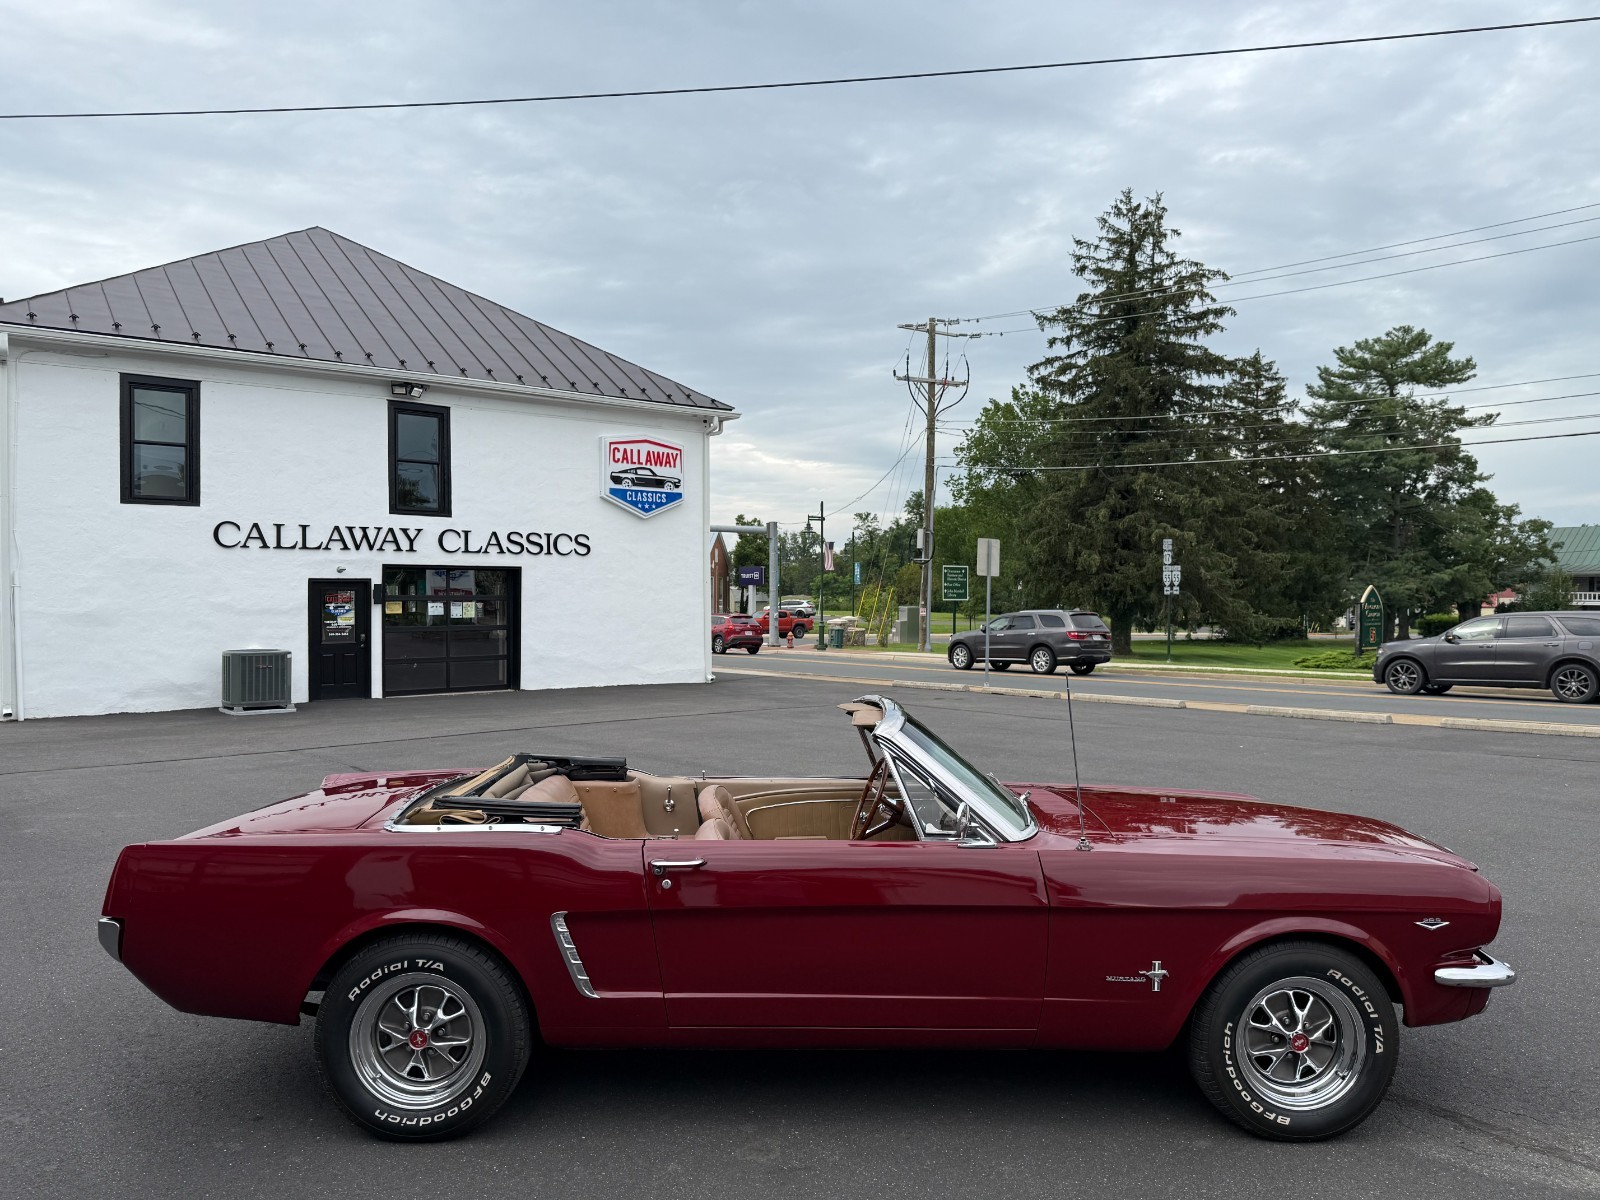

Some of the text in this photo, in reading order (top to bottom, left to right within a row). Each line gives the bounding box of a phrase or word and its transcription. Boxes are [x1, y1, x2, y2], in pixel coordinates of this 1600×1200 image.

[612, 446, 678, 468] CALLAWAY
[626, 491, 666, 502] CLASSICS
[212, 520, 591, 556] CALLAWAY CLASSICS
[348, 959, 445, 1001] Radial T/A
[1326, 968, 1384, 1054] Radial T/A
[1222, 1022, 1291, 1126] BFGoodrich
[374, 1071, 492, 1127] BFGoodrich
